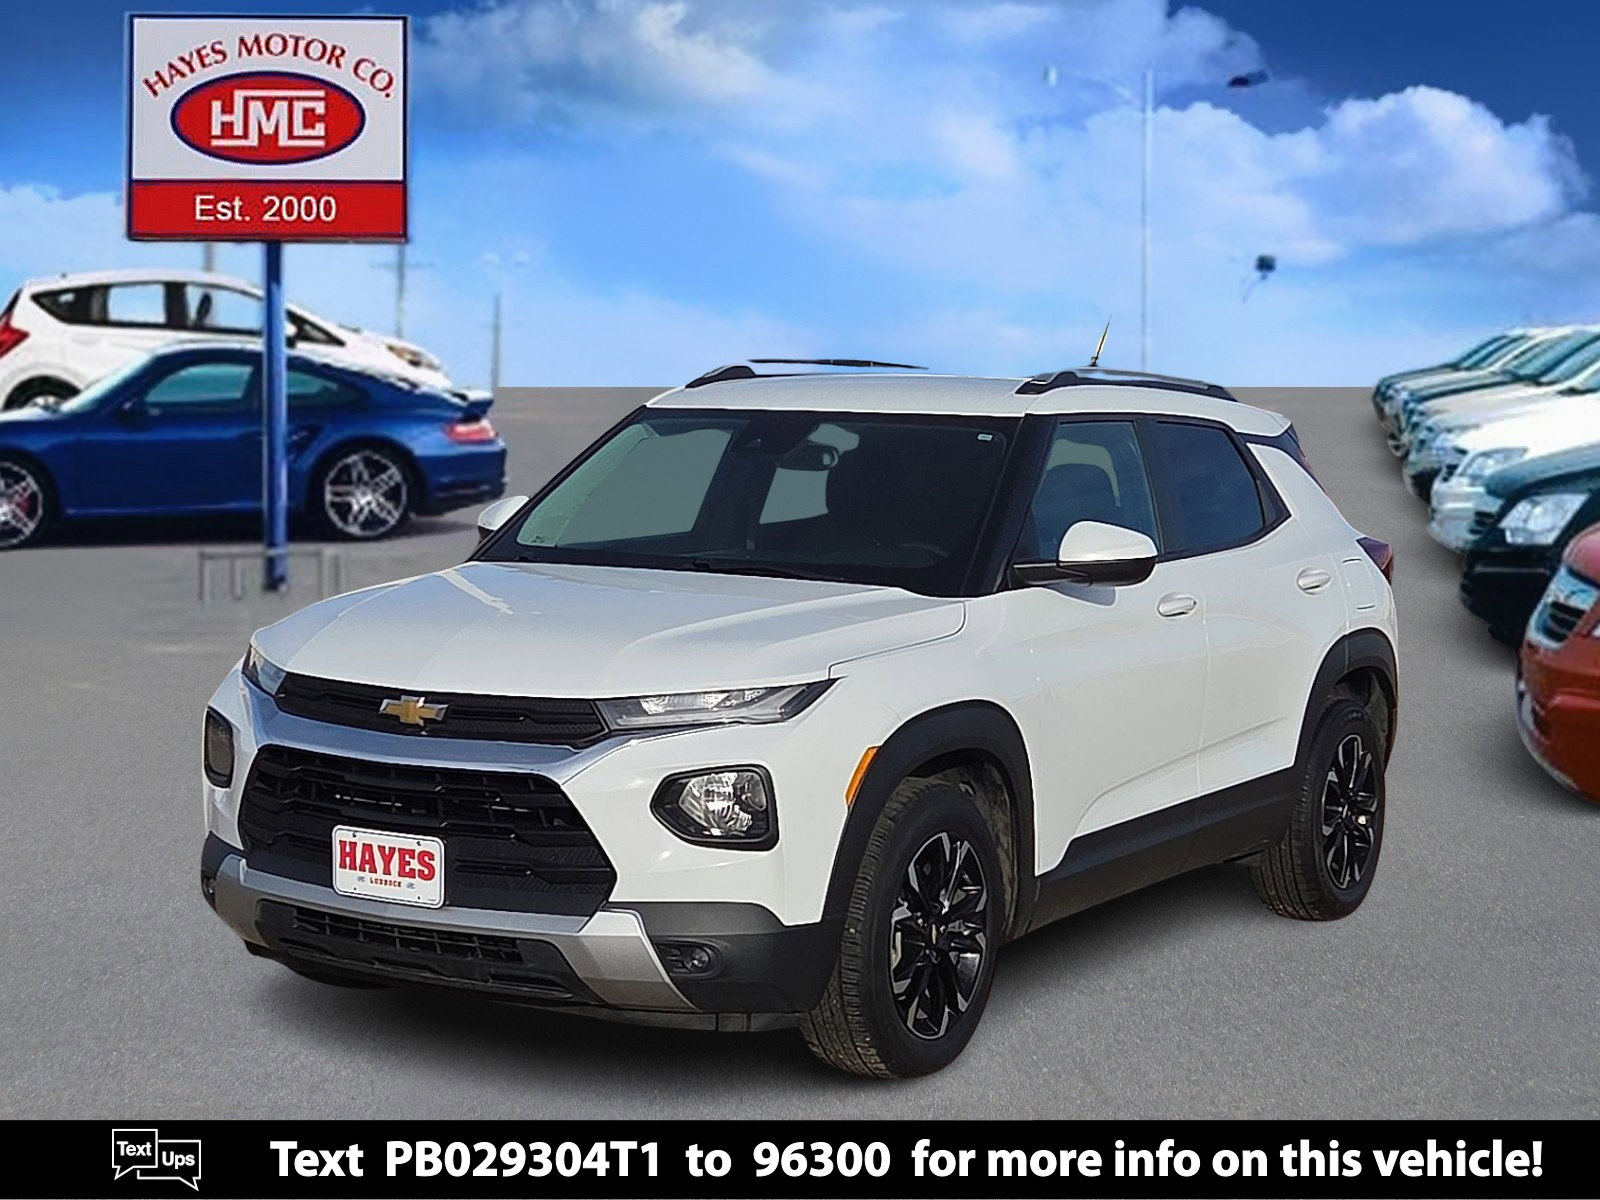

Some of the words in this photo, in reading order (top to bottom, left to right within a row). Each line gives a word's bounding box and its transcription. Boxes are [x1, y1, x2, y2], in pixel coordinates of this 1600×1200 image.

[143, 40, 228, 97] HAYES
[237, 33, 347, 70] MOTOR
[352, 57, 395, 99] CO.
[210, 88, 326, 148] HMC
[194, 194, 251, 222] Est.
[262, 196, 337, 222] 2000
[339, 839, 436, 882] HAYES
